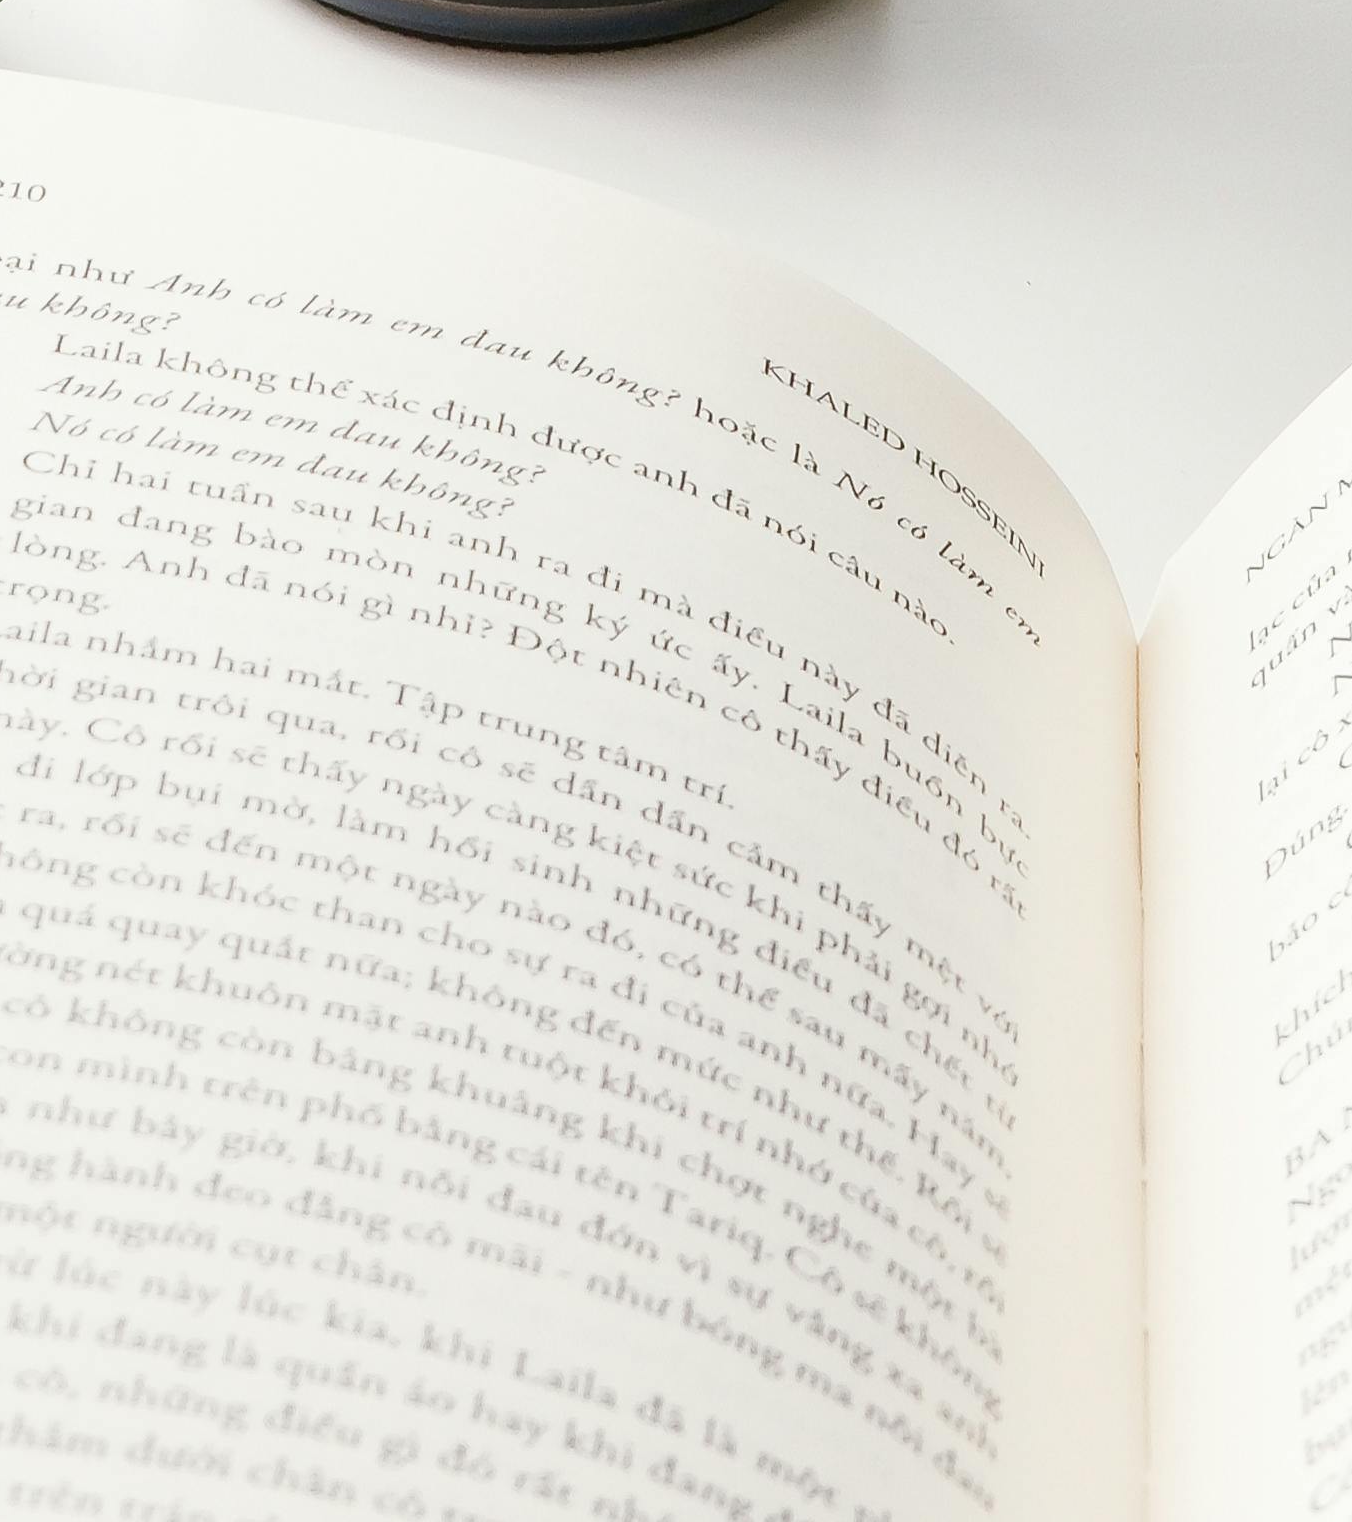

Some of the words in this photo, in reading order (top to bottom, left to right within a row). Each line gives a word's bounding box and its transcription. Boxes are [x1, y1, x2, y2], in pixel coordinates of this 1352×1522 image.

[38, 375, 123, 402] Anh
[264, 414, 319, 434] em
[53, 333, 143, 367] Laila
[633, 462, 698, 498] anh
[145, 273, 232, 301] Anh
[390, 319, 444, 340] em
[1005, 606, 1041, 647] em
[231, 449, 286, 468] em
[761, 356, 906, 451] KHALED
[914, 447, 1045, 580] HOSSEINI
[113, 460, 171, 492] hai
[291, 499, 352, 523] sau
[370, 505, 432, 540] khi
[448, 533, 518, 562] anh
[537, 555, 570, 577] ra
[121, 549, 208, 582] Anh
[9, 494, 93, 522] gian
[779, 681, 864, 746] Laila
